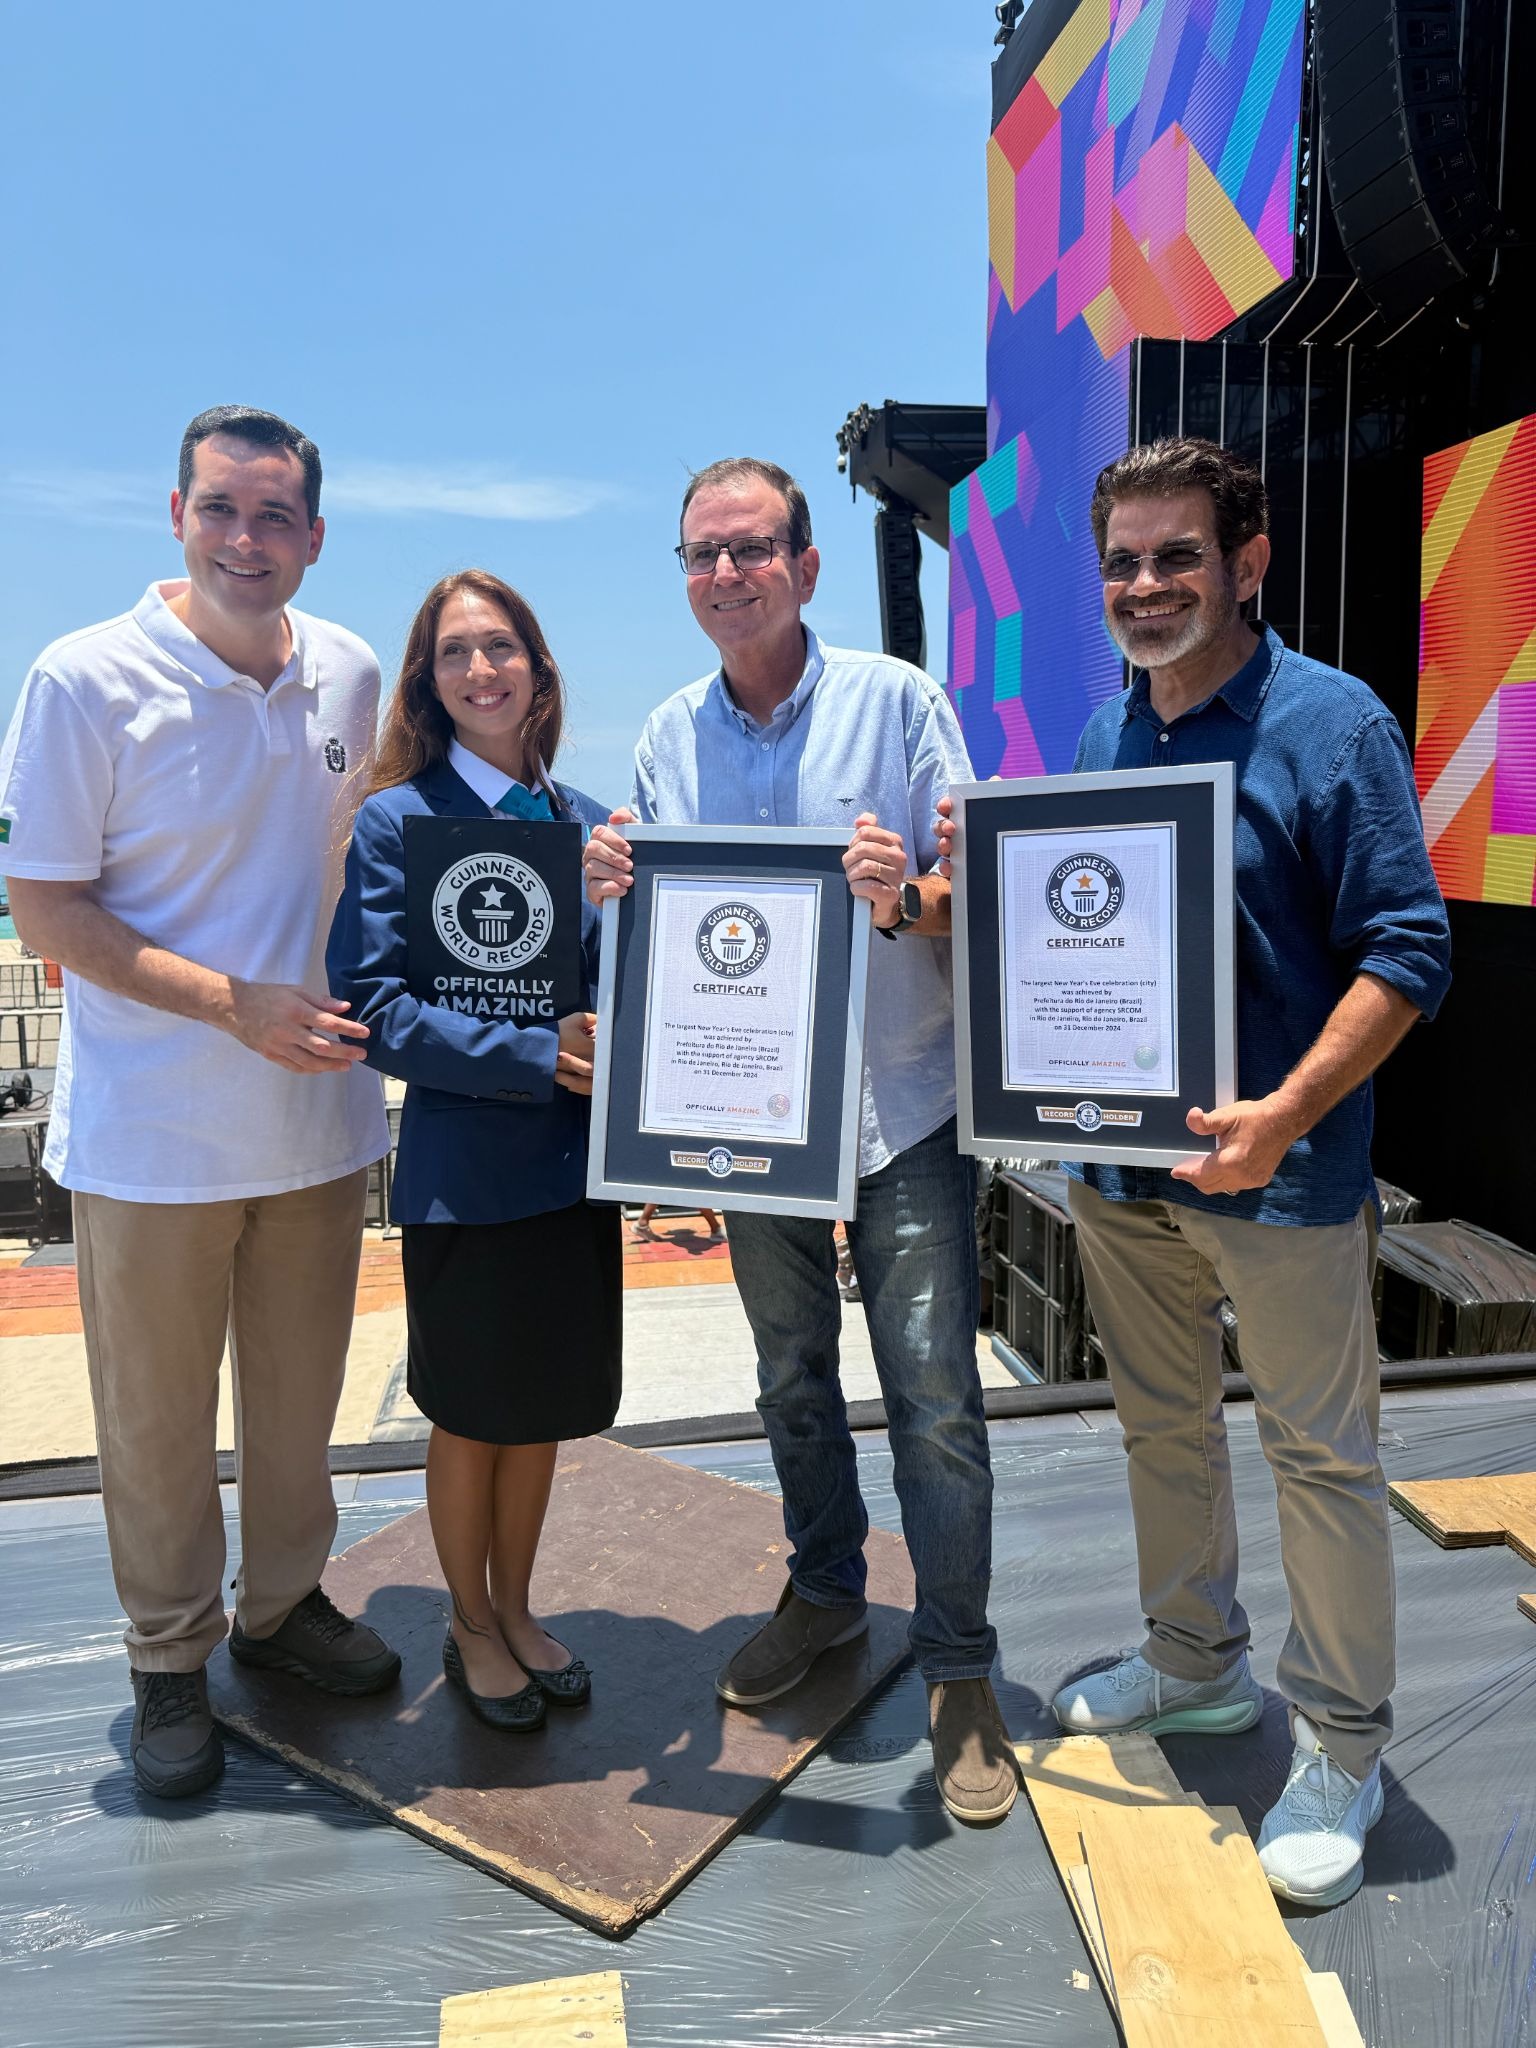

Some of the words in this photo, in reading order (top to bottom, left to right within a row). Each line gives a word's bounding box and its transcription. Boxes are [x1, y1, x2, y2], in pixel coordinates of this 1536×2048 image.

[1056, 858, 1114, 880] GUINNESS
[450, 861, 536, 892] GUINNESS
[1050, 888, 1076, 924] WORLD
[1080, 886, 1120, 927] RECORDS
[708, 906, 762, 928] GUINNESS
[441, 904, 480, 958] WORLD
[487, 907, 546, 964] RECORDS
[1046, 937, 1125, 948] CERTIFICATE
[700, 934, 723, 972] WORLD
[726, 936, 766, 974] RECORDS
[434, 976, 555, 995] OFFICIALLY
[693, 983, 768, 996] CERTIFICATE
[1140, 980, 1157, 988] (city)
[436, 995, 555, 1017] AMAZING
[1120, 998, 1142, 1006] (Brazil)
[778, 1029, 794, 1037] (city)
[696, 1060, 720, 1068] Janeiro,
[712, 1070, 742, 1078] December
[685, 1103, 725, 1112] OFFICIALLY
[726, 1106, 760, 1115] AMAZING
[734, 1160, 763, 1168] HOLDER
